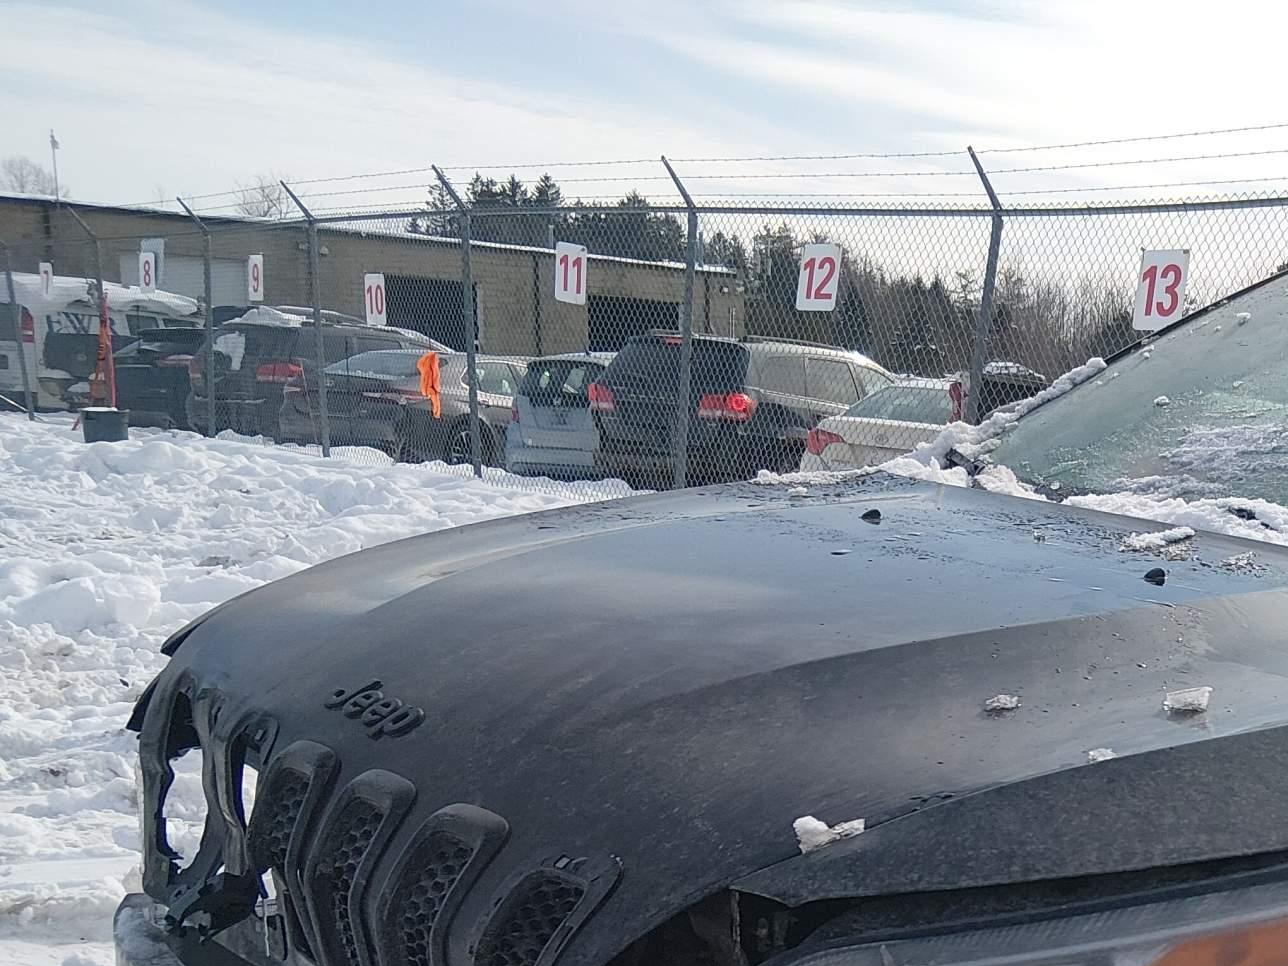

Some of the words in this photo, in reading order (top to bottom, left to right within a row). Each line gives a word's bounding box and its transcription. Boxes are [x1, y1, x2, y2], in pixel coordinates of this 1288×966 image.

[143, 260, 151, 287] 8
[252, 263, 260, 293] 9
[560, 254, 582, 294] 11
[804, 255, 837, 300] 12
[1141, 263, 1184, 317] 13
[366, 284, 384, 315] 10
[323, 678, 426, 742] Jeep
